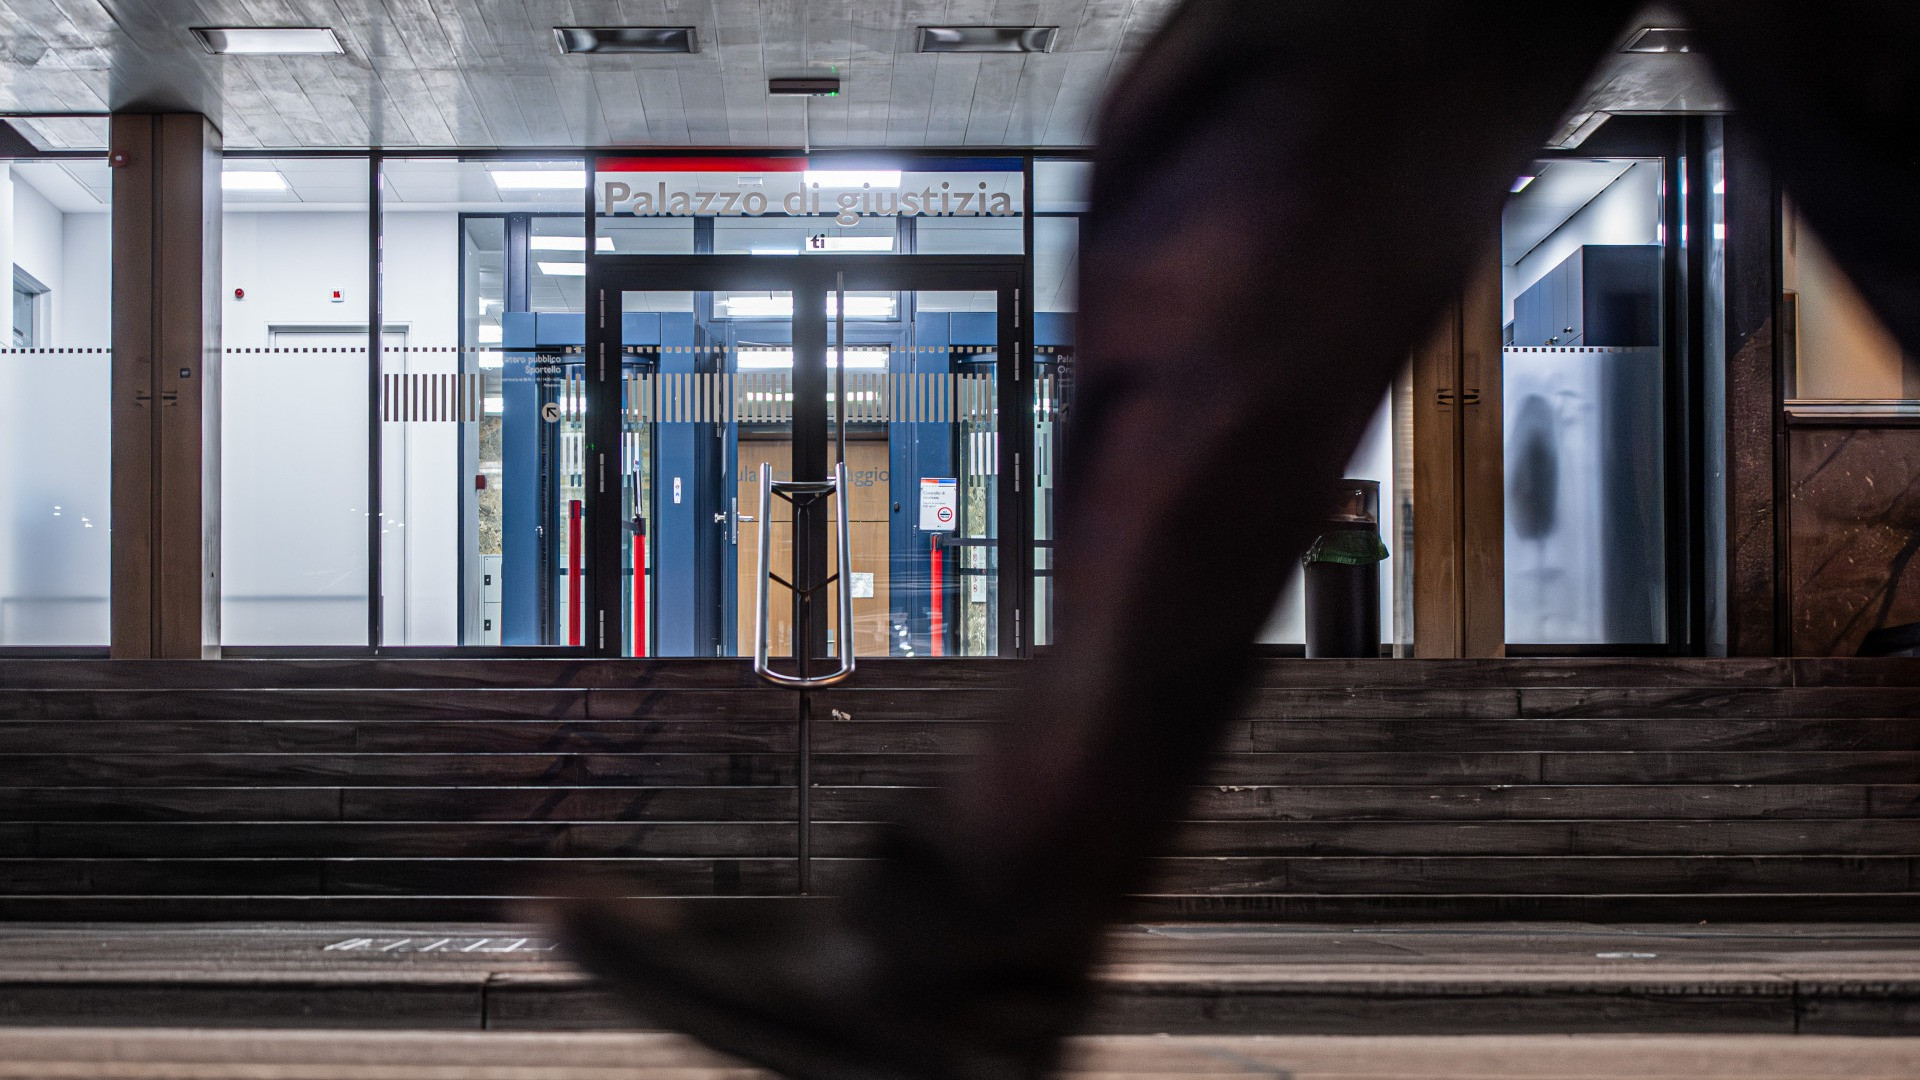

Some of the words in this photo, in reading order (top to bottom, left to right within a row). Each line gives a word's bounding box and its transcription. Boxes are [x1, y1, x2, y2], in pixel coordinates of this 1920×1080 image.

[604, 181, 768, 217] Palazzo
[783, 181, 820, 217] di
[835, 181, 1015, 227] giustizia
[810, 233, 826, 249] ti
[525, 365, 561, 375] Sportello
